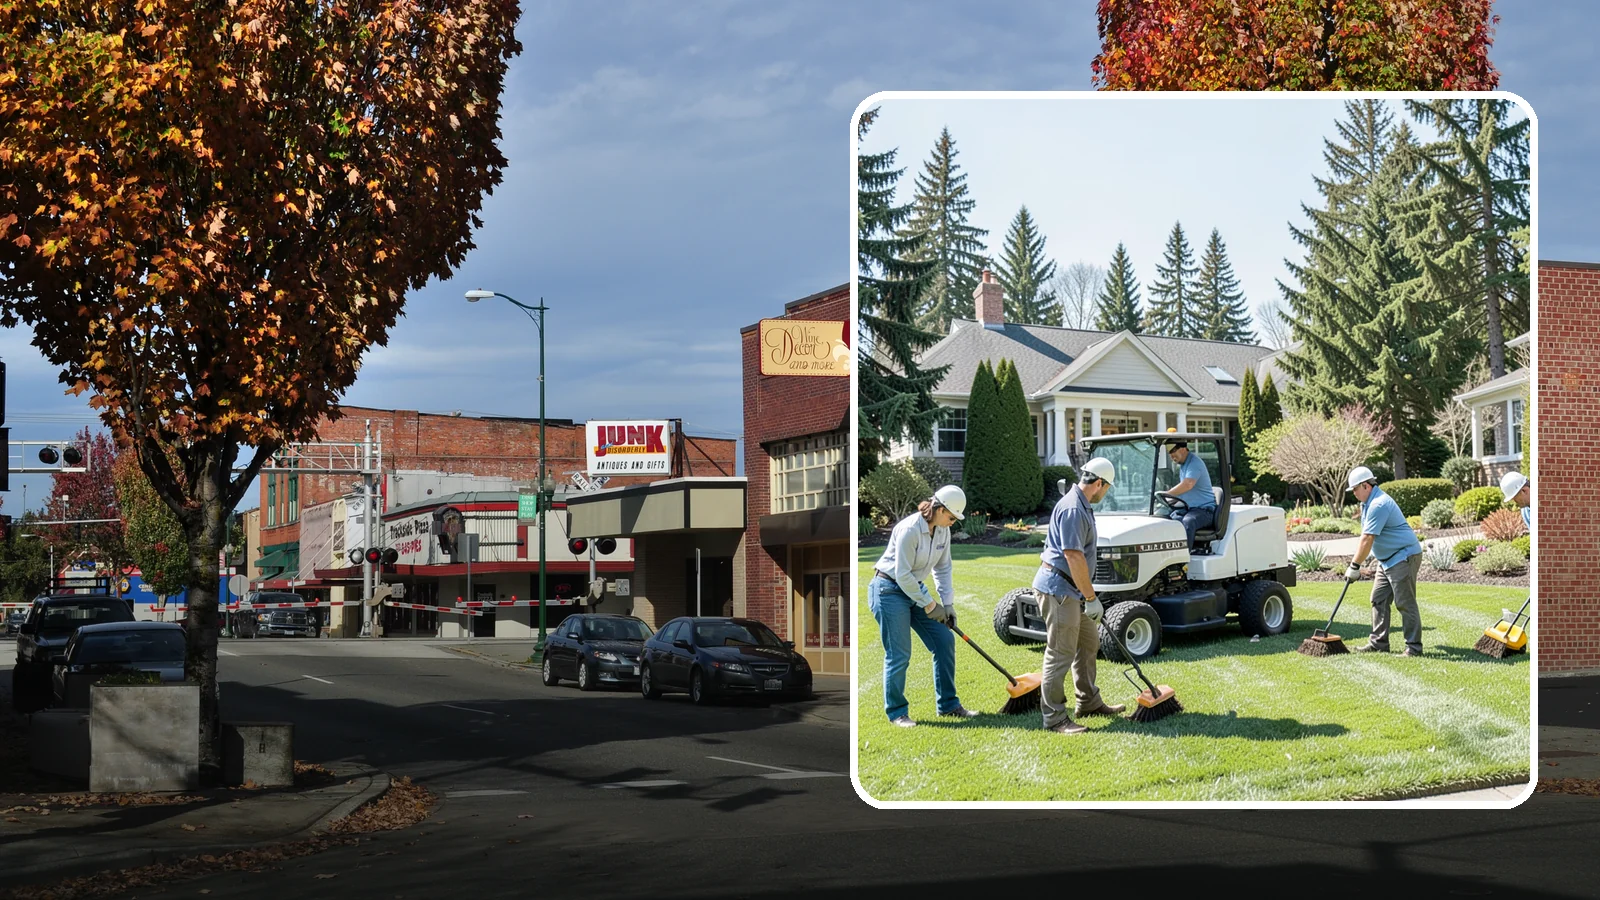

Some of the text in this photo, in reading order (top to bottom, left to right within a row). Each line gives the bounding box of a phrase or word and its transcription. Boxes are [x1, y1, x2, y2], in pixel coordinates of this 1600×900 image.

[595, 425, 665, 457] JUNK
[607, 446, 646, 454] DISORDERLY
[597, 460, 665, 470] ANTIQUES AND GIFTS
[590, 476, 608, 491] SING
[390, 519, 429, 540] Trackside Pizza
